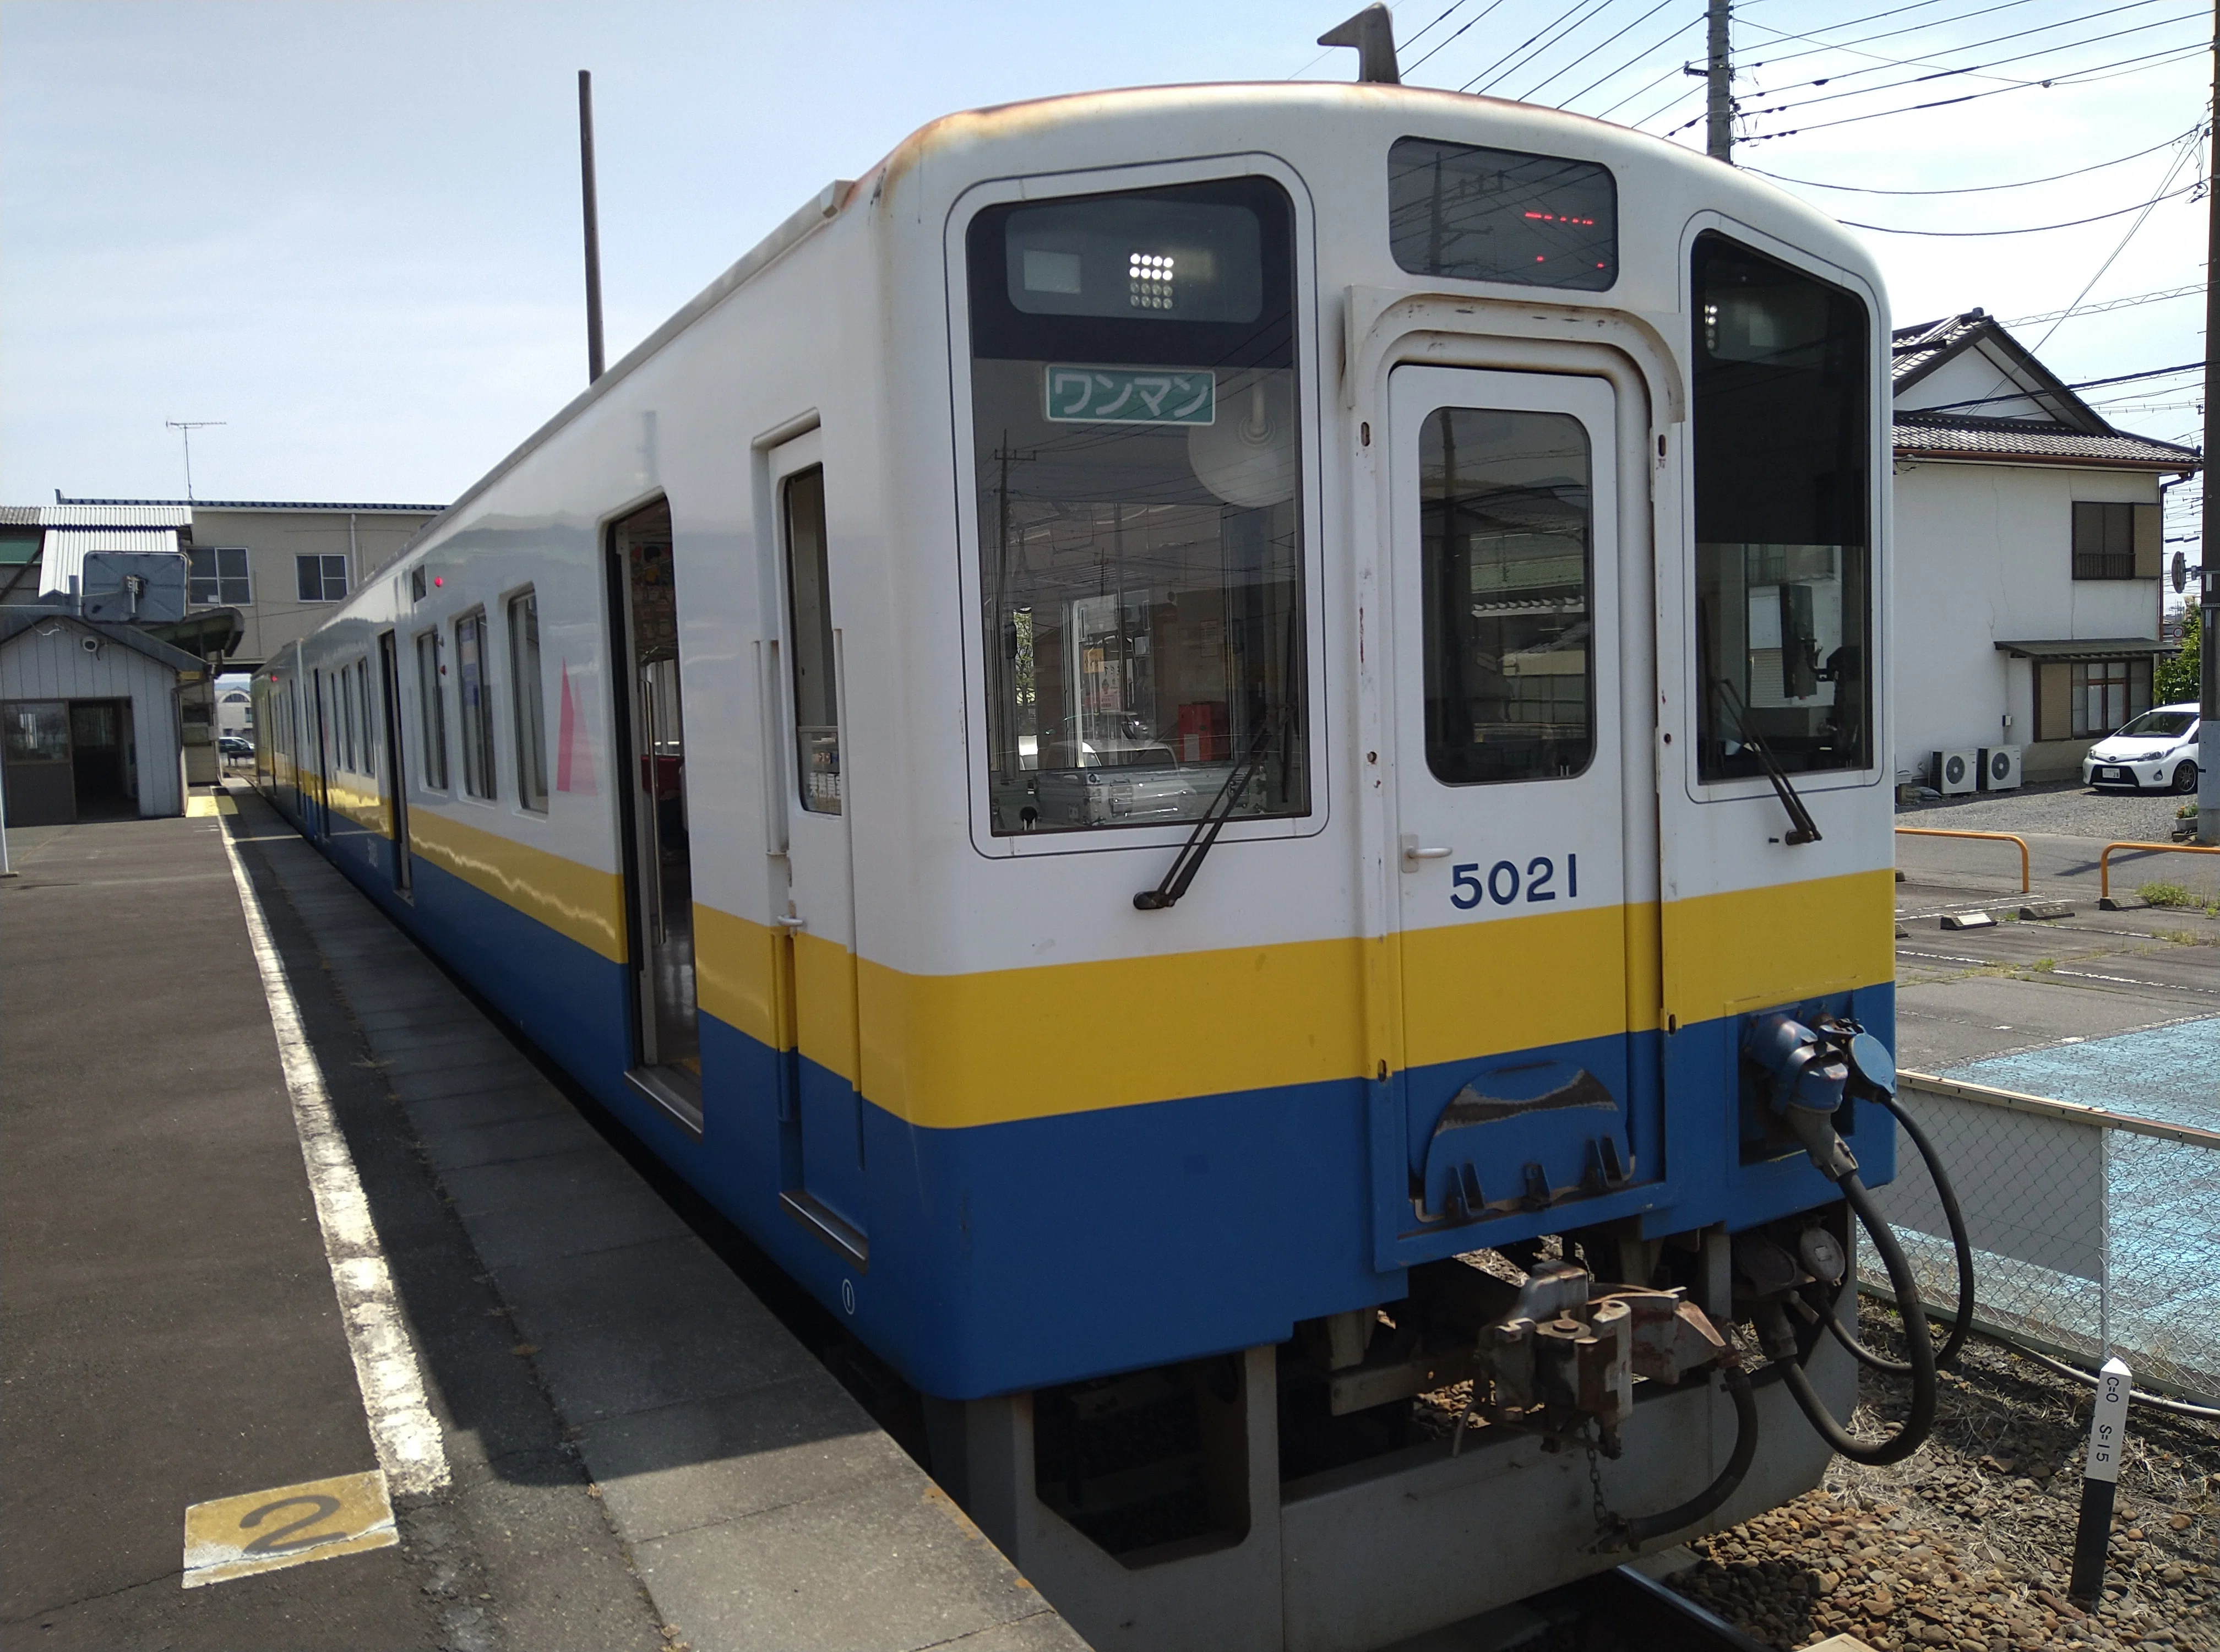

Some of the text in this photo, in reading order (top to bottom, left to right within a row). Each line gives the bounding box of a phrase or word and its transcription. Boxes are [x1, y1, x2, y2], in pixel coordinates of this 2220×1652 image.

[1055, 374, 1209, 417] ワンマン
[1450, 854, 1577, 909] 5021
[2096, 1377, 2119, 1462] C=0 S=15
[240, 1495, 348, 1556] 2
